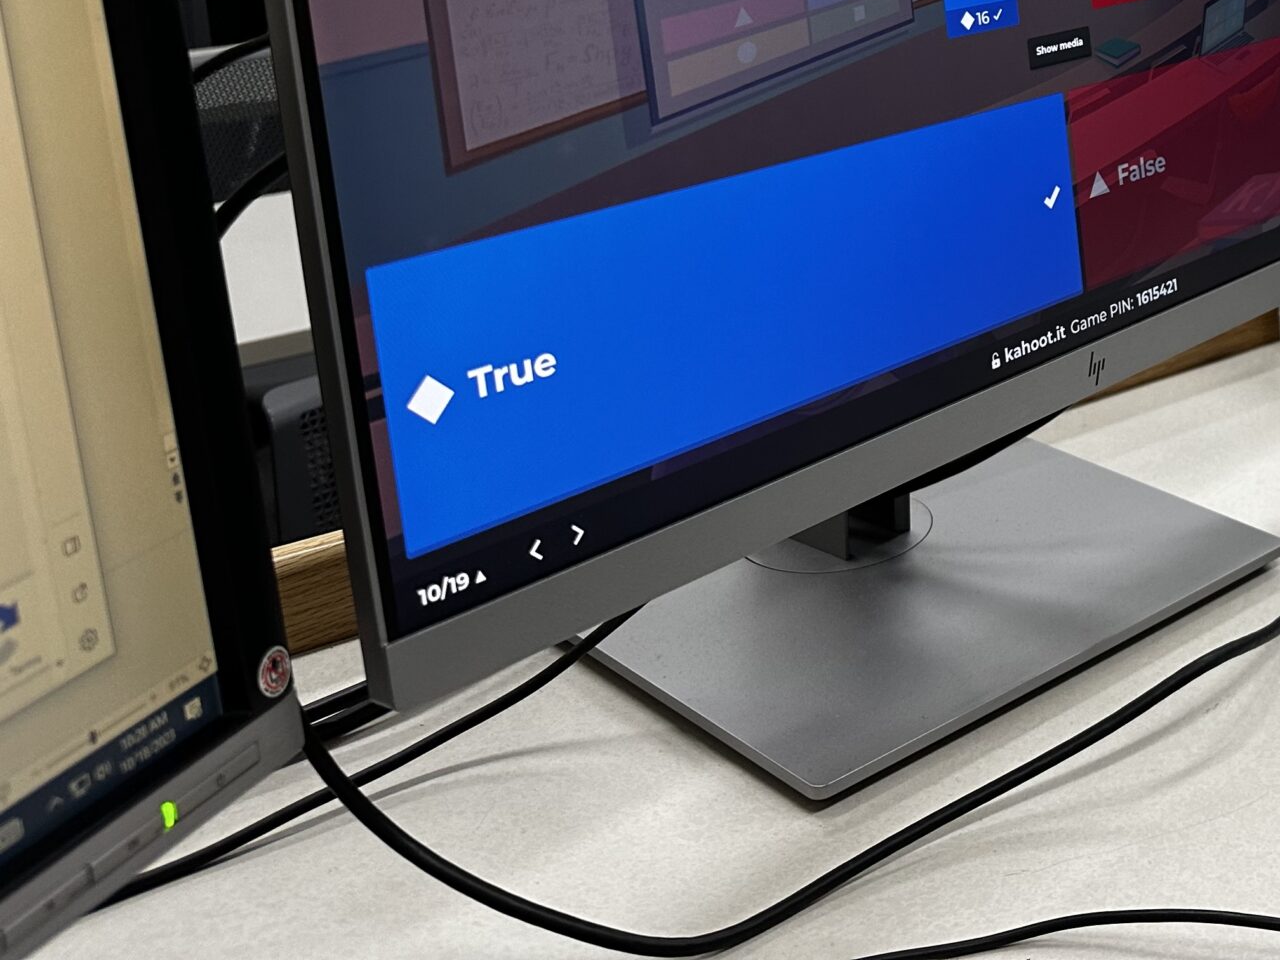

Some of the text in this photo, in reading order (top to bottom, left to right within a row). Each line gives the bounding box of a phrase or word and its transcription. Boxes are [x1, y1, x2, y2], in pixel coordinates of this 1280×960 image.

[975, 10, 991, 26] 16
[1035, 37, 1084, 56] Show media
[1117, 156, 1166, 186] False
[1004, 278, 1179, 362] kahoot.it Game PIN: 1615421
[467, 352, 557, 399] True
[417, 572, 471, 606] 10/19
